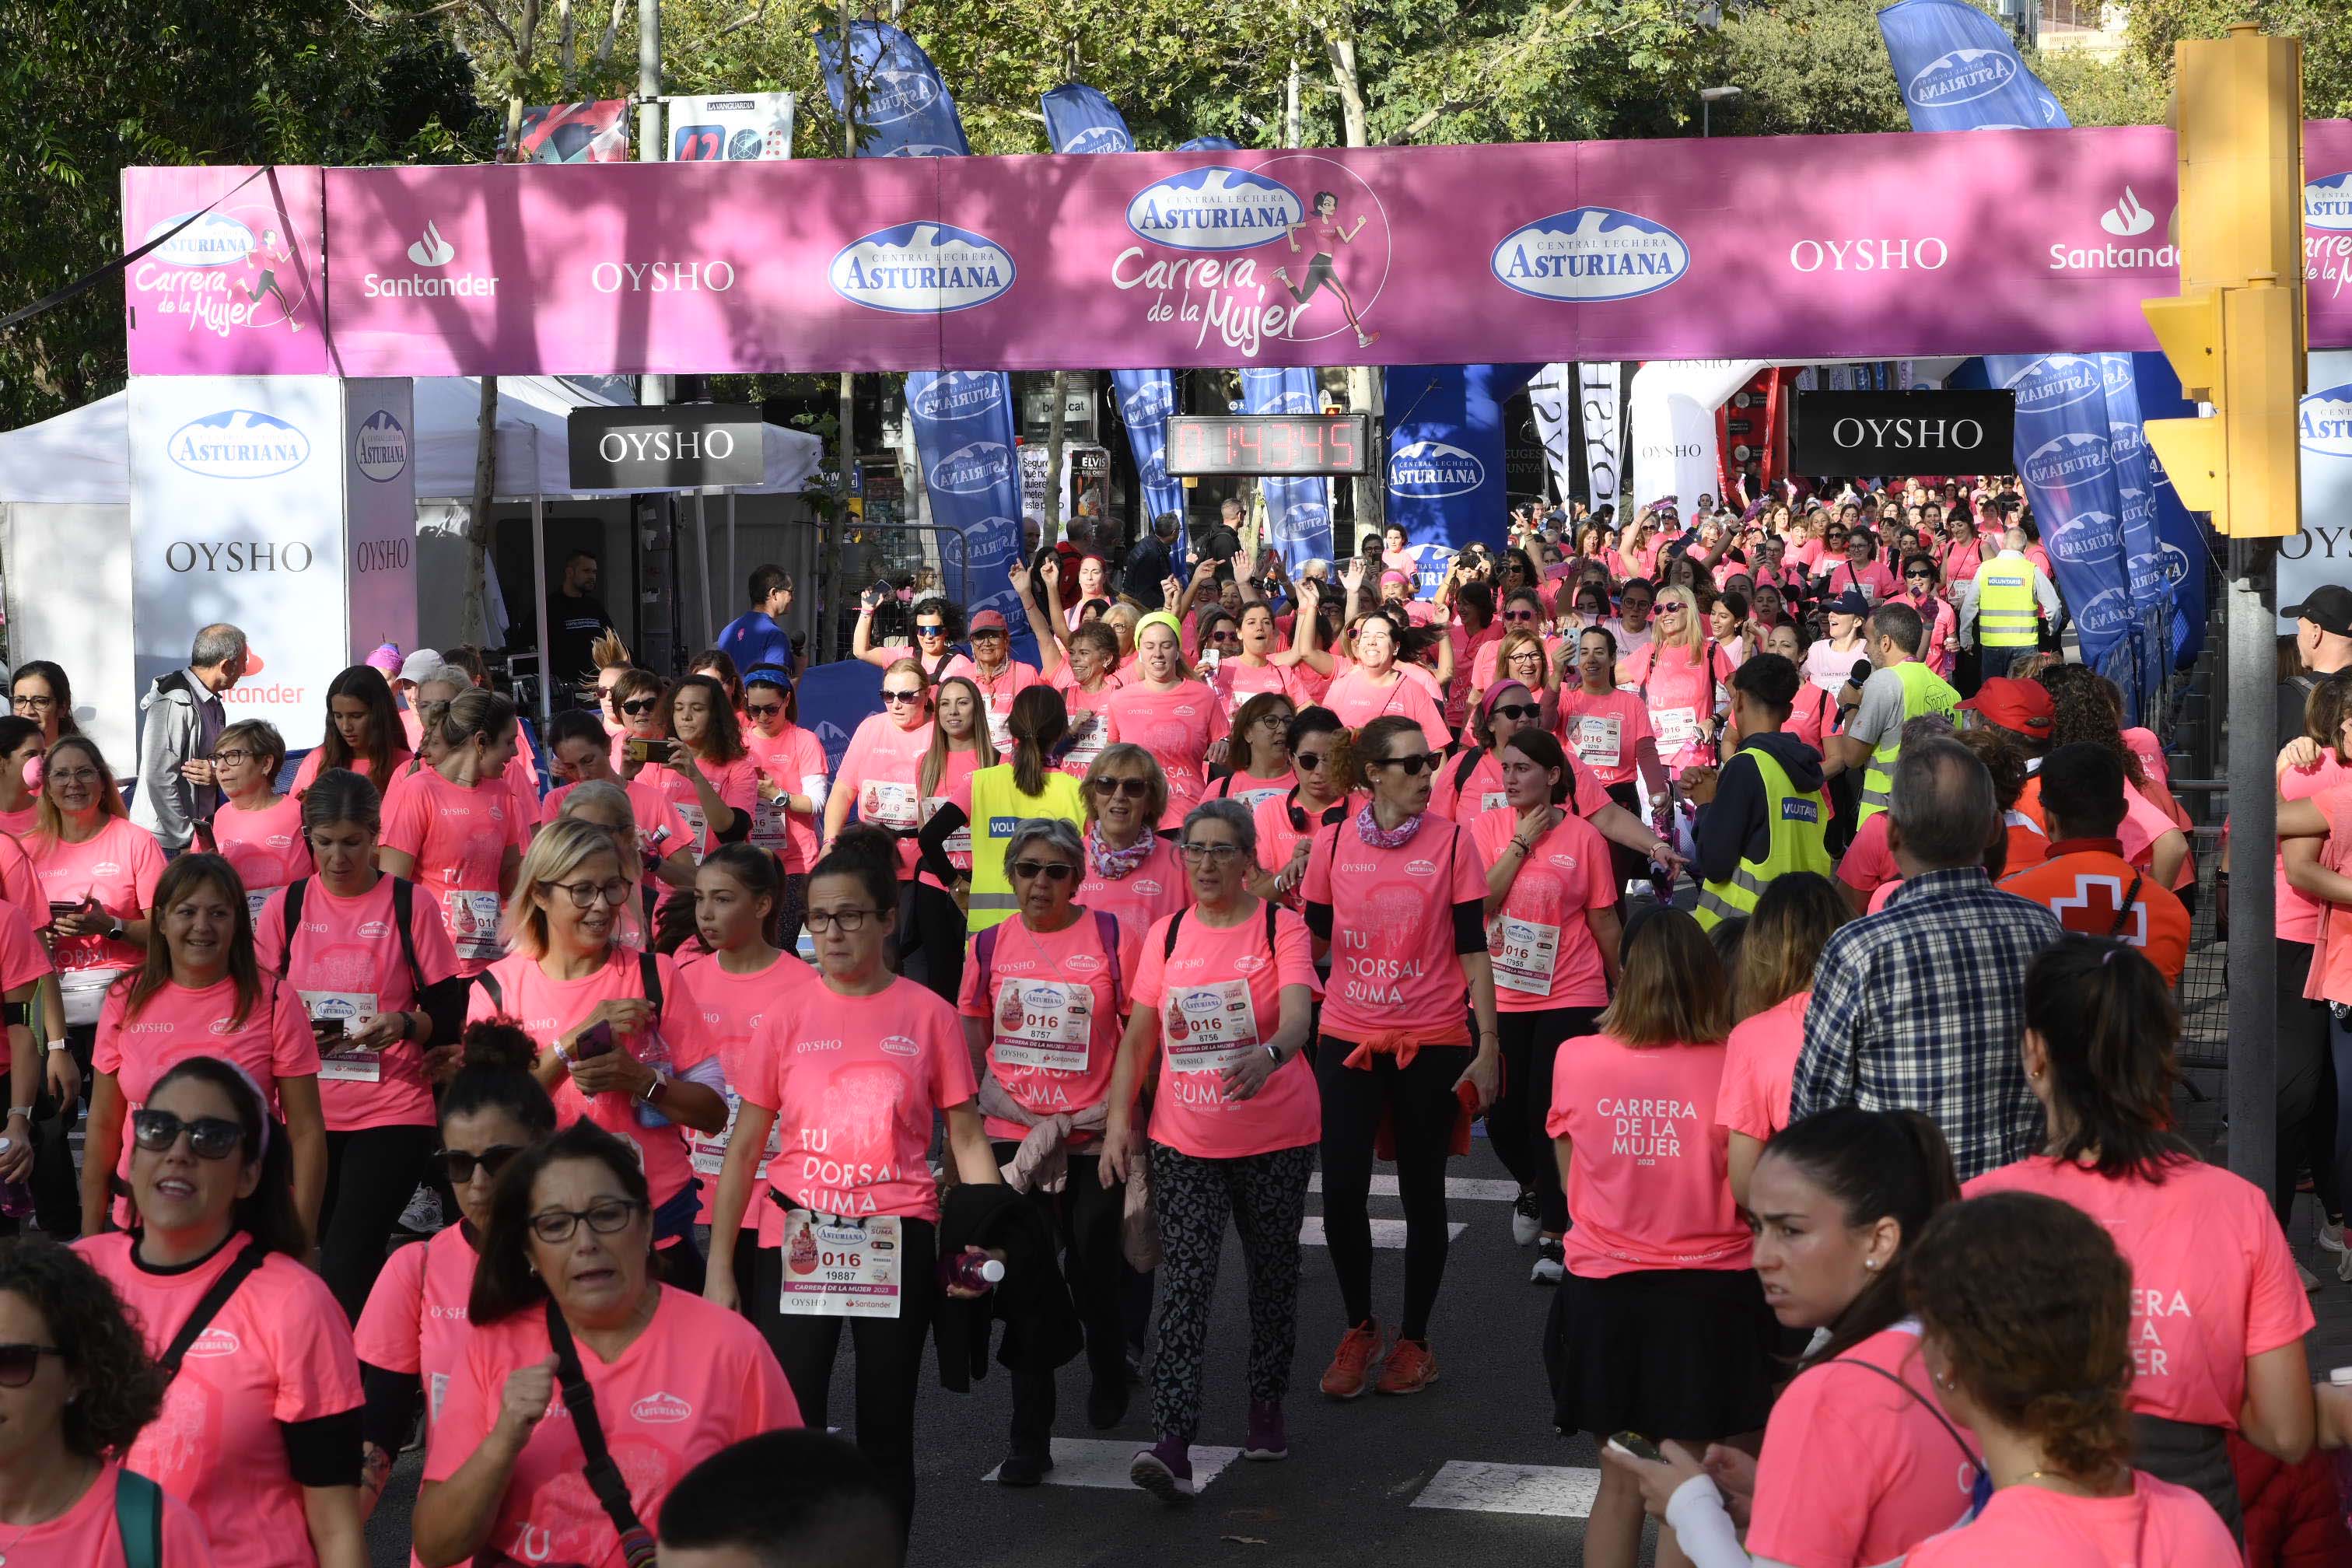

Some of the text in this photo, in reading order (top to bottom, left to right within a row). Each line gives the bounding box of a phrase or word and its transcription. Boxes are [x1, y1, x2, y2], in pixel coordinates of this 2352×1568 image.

[1167, 194, 1285, 204] CENTRAL LECHERA
[1140, 198, 1288, 229] ASTURIANA
[1537, 239, 1668, 250] CENTRAL LECHERA
[872, 252, 995, 262] CENTRAL LECHERA
[1507, 243, 1674, 278] ASTURIANA
[1790, 237, 1948, 272] OYSHO
[2049, 243, 2182, 269] Santand
[844, 256, 1002, 289] ASTURIANA
[1111, 247, 1256, 289] Carrera
[2322, 257, 2336, 280] la
[135, 263, 228, 292] Carrera
[592, 261, 734, 292] OYSHO
[365, 274, 499, 298] Santander
[158, 285, 261, 337] de la Mujer
[1147, 285, 1311, 357] de la Mujer
[1832, 418, 1983, 450] OYSHO
[178, 436, 299, 461] ASTURIANA
[359, 439, 404, 464] ASTURIANA
[599, 429, 734, 464] OYSHO
[1642, 443, 1702, 460] OYSHO
[1082, 457, 1105, 467] ELVIS
[1390, 464, 1477, 486] ASTURIANA
[166, 541, 313, 572] OYSHO
[357, 537, 409, 573] OYSHO
[1584, 735, 1602, 744] 016
[1342, 863, 1377, 873] OYSHO
[1344, 930, 1367, 949] TU
[1507, 929, 1533, 941] ASTURIANA
[1506, 945, 1529, 959] 016
[999, 960, 1036, 973] OYSHO
[1174, 957, 1205, 970] OYSHO
[1027, 992, 1062, 1006] ASTURIANA
[1224, 991, 1243, 999] SUMA
[1345, 981, 1404, 1004] SUMA
[319, 1006, 354, 1016] ASTURIANA
[1185, 999, 1219, 1010] ASTURIANA
[131, 1023, 174, 1034] OYSHO
[1026, 1013, 1059, 1029] 016
[1191, 1017, 1223, 1033] 016
[1004, 1038, 1028, 1047] CARRERA
[1031, 1030, 1051, 1039] 8757
[1199, 1033, 1219, 1042] 8756
[796, 1039, 842, 1053] OYSHO
[1001, 1049, 1028, 1059] OYSHO
[1051, 1055, 1080, 1064] Santander
[1177, 1057, 1203, 1066] OYSHO
[1224, 1050, 1253, 1062] Santander
[1007, 1082, 1069, 1106] SUMA
[1597, 1097, 1698, 1120] CARRERA
[1615, 1118, 1677, 1138] DE LA
[801, 1129, 828, 1153] TU
[1612, 1138, 1681, 1157] MUJER
[798, 1188, 877, 1215] SUMA
[821, 1228, 863, 1241] ASTURIANA
[822, 1251, 862, 1267] 016
[825, 1271, 856, 1281] 19887
[848, 1285, 872, 1293] MUJER
[873, 1286, 890, 1294] 2023
[791, 1297, 827, 1307] OYSHO
[854, 1299, 891, 1309] Santander
[635, 1405, 688, 1418] ASTURIANA
[512, 1521, 551, 1562] TU
